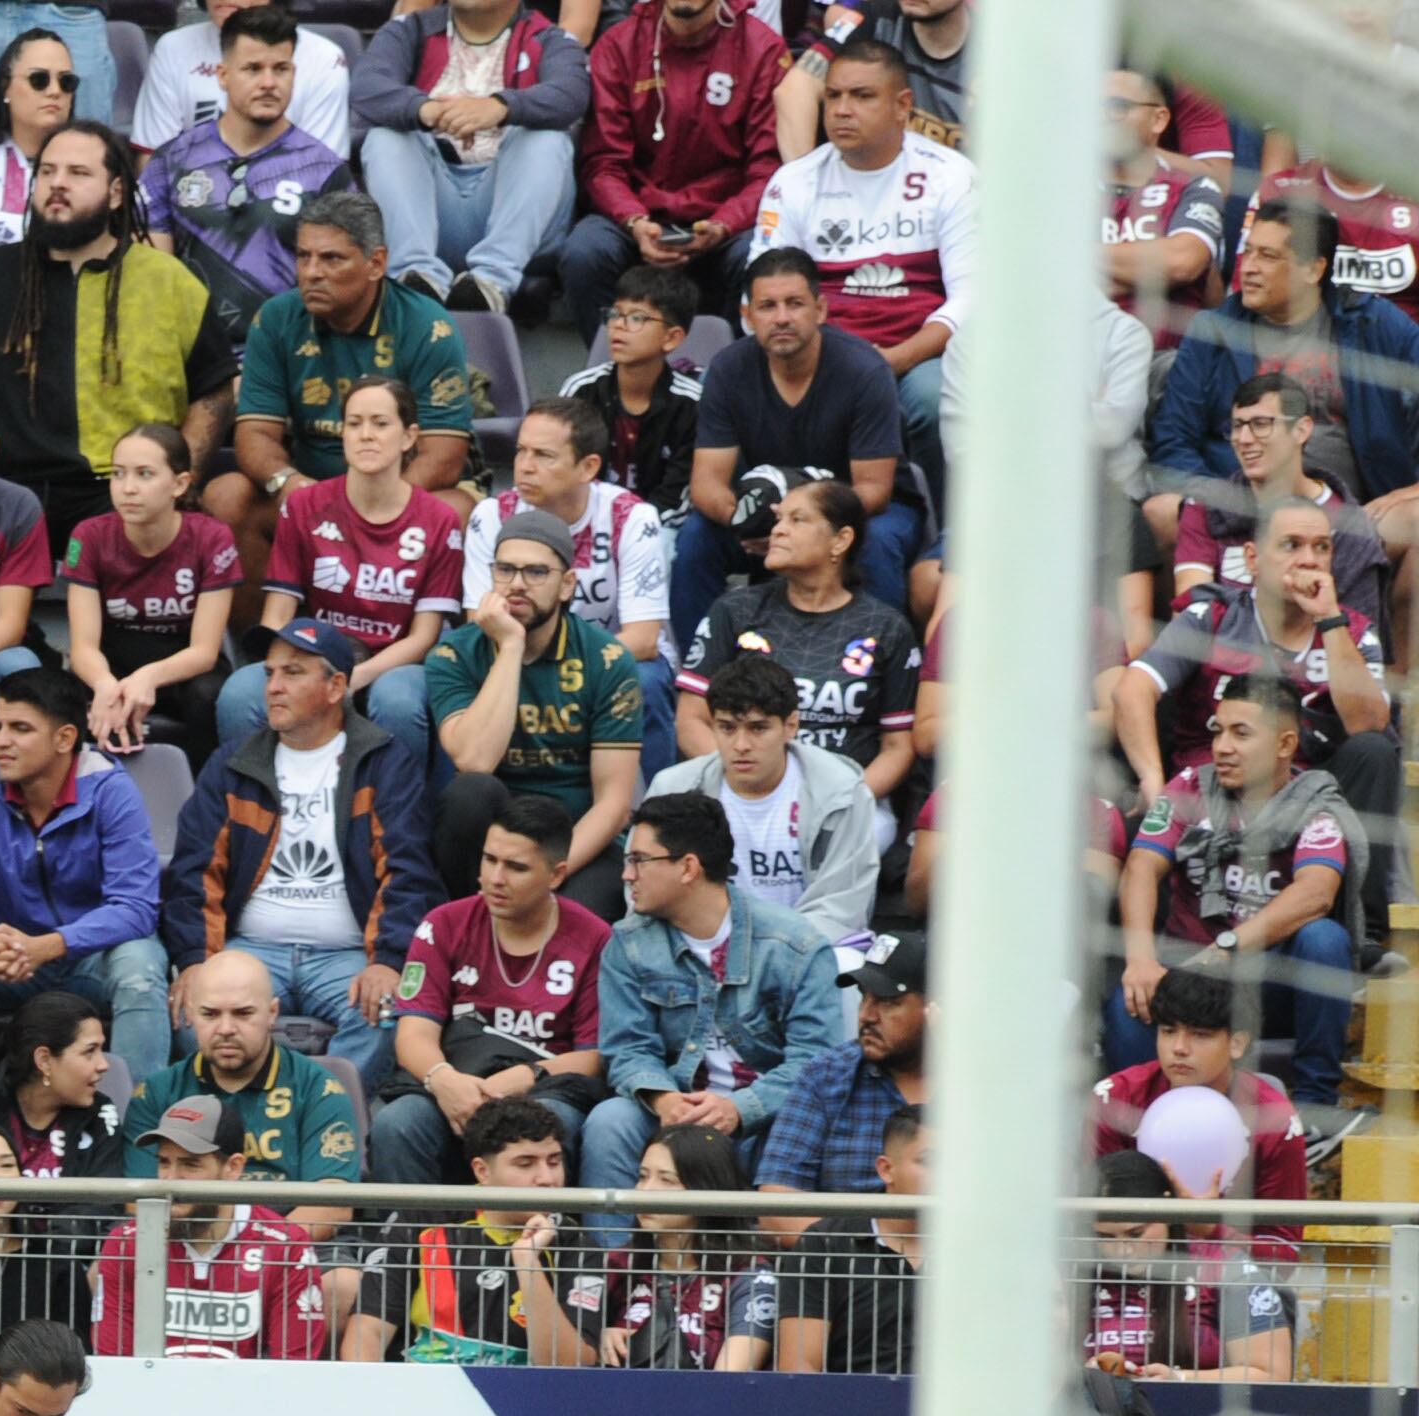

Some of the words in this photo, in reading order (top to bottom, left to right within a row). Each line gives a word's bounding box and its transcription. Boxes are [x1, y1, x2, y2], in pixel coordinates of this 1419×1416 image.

[705, 71, 732, 107] S
[272, 181, 303, 217] S
[903, 171, 928, 201] S
[1143, 183, 1171, 209] S
[1102, 213, 1159, 246] BAC
[1391, 206, 1411, 229] S
[1335, 249, 1406, 281] IMBO
[374, 336, 395, 369] S
[398, 526, 427, 561] S
[592, 532, 611, 564] S
[174, 569, 195, 596] S
[356, 562, 418, 599] BAC
[145, 597, 196, 618] BAC
[315, 608, 403, 638] LIBERTY
[560, 660, 584, 693] S
[522, 703, 583, 735] BAC
[1226, 865, 1282, 896] BAC
[545, 960, 574, 995] S
[493, 1005, 555, 1040] BAC
[266, 1087, 292, 1119] S
[243, 1247, 263, 1272] S
[700, 1284, 723, 1311] S
